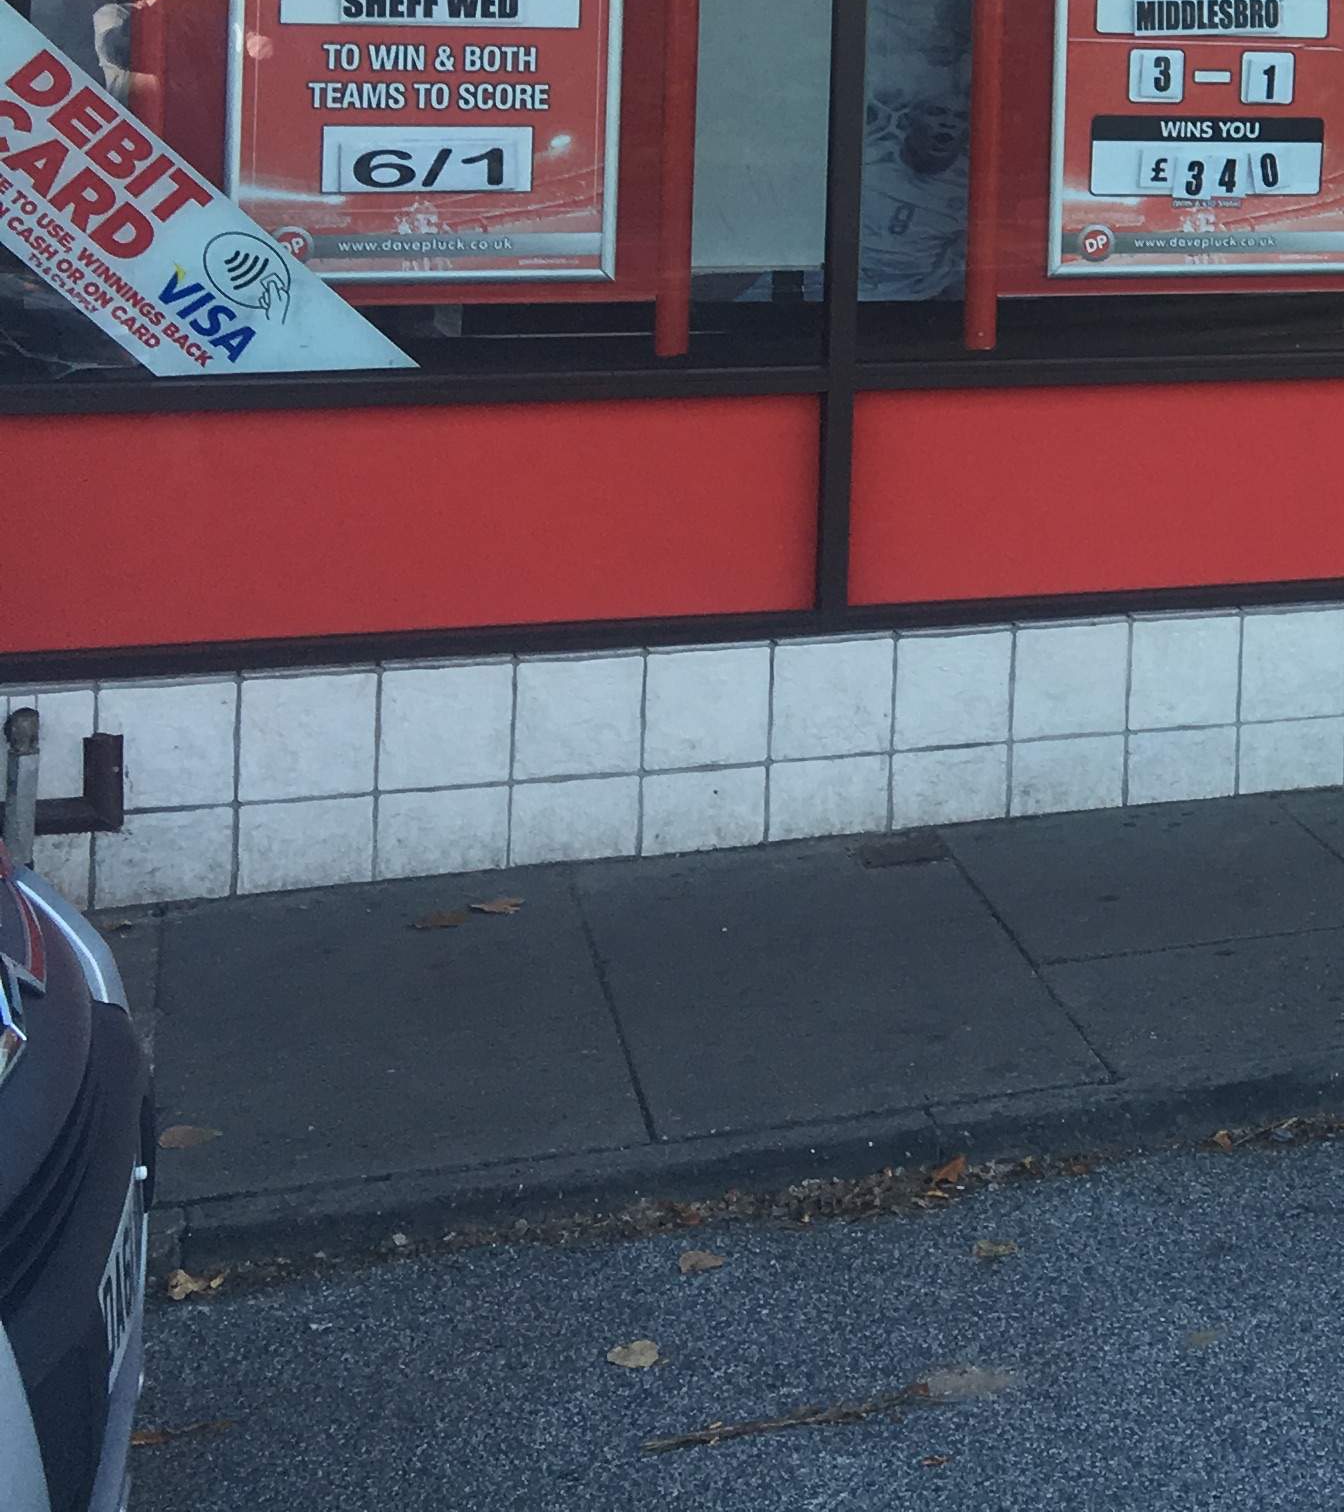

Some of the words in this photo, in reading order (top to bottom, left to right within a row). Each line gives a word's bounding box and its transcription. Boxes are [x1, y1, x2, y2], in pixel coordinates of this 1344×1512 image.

[323, 43, 360, 72] TO
[370, 44, 424, 72] WIN
[435, 44, 456, 73] &
[464, 46, 537, 73] BOTH
[1154, 56, 1172, 92] 3
[1263, 64, 1277, 100] 1
[308, 81, 405, 110] TEAMS
[413, 82, 449, 110] TO
[458, 83, 549, 110] SCORE
[5, 49, 214, 223] DEBIT
[1161, 121, 1213, 139] WINS
[1219, 122, 1261, 139] YOU
[353, 147, 504, 188] 6/1
[1085, 234, 1109, 254] DP
[7, 216, 59, 261] CASH
[56, 258, 85, 285] OR
[83, 282, 114, 309] ON
[111, 306, 161, 349] CARD
[11, 190, 38, 216] TO
[36, 212, 75, 254] USE,
[77, 247, 166, 326] WINNINGS
[162, 322, 214, 368] BACK
[65, 286, 99, 314] APPLY
[158, 263, 256, 363] VISA
